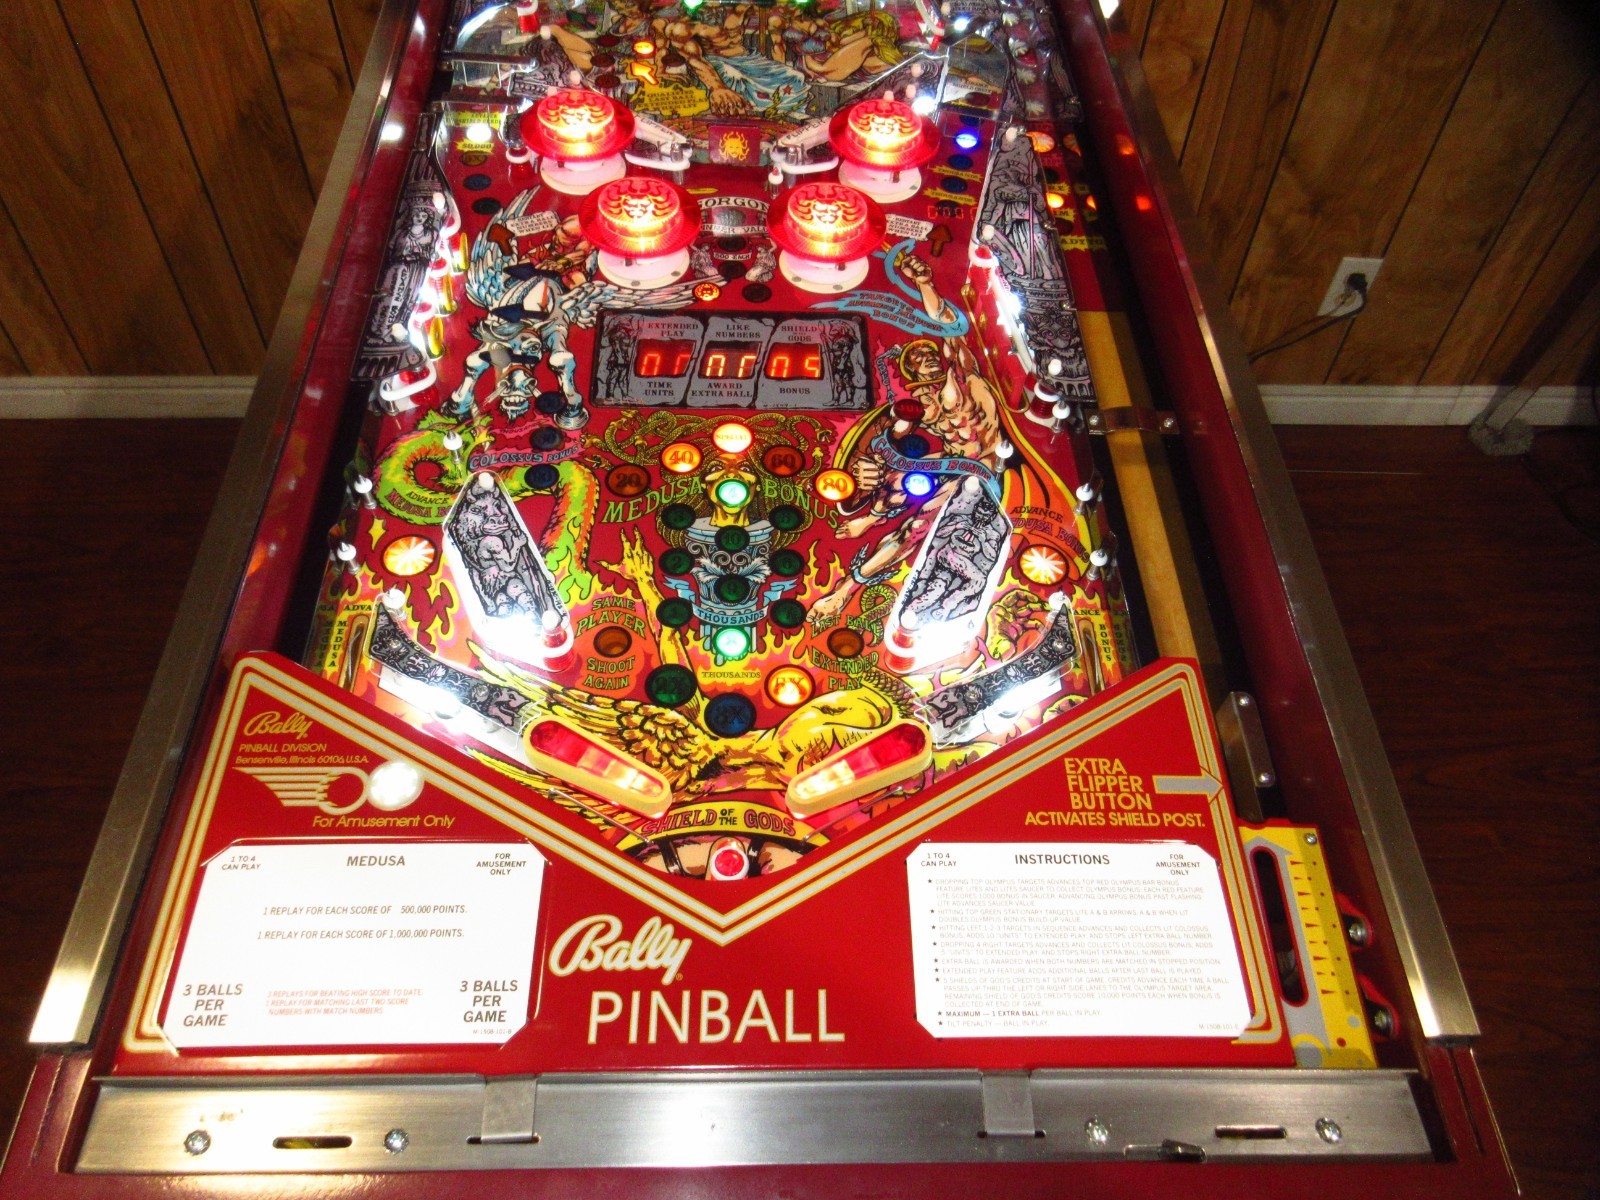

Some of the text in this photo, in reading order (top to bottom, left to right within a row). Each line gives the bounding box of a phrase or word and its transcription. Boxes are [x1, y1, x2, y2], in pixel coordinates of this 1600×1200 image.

[468, 444, 580, 470] COLOSSUS BONUS
[668, 450, 695, 466] 40
[874, 438, 992, 480] COLOSSUS BONUS
[822, 477, 849, 492] 80
[385, 488, 432, 518] MEDUSA
[406, 490, 450, 505] ADVANCE
[601, 478, 839, 530] MEDUSA BONUS
[1010, 506, 1064, 524] ADVANCE
[1055, 526, 1090, 564] BONUS
[591, 596, 637, 610] SAME
[576, 609, 648, 640] PLAYER
[695, 608, 766, 626] THOUSANDS
[809, 616, 883, 638] LAST BALL
[1099, 624, 1112, 662] BONUS
[586, 655, 636, 674] SHOOT
[809, 648, 880, 674] EXTENDED
[582, 675, 631, 690] AGAIN
[700, 670, 762, 680] THOUSANDS
[828, 677, 865, 690] PLAY
[243, 711, 313, 740] Bally
[239, 743, 328, 753] PINBALL DIVISION
[1064, 758, 1128, 776] EXTRA
[1066, 774, 1144, 793] FLIPPER
[1069, 792, 1153, 811] BUTTON
[312, 814, 456, 828] For Amusement Only
[641, 808, 797, 838] SHIELD OF THE GODS
[1024, 811, 1206, 828] ACTIVATES SHIELD POST.
[346, 855, 406, 867] MEDUSA
[1014, 854, 1110, 866] INSTRUCTIONS
[264, 905, 468, 916] 1 REPLAY FOR EACH SCORE OF 500,000 POINTS.
[257, 930, 465, 940] 1 REPLAY FOR EACH SCORE OF 1,000,000 POINTS.
[548, 914, 692, 986] Bally
[182, 984, 244, 996] 3 BALLS
[460, 980, 519, 992] 3 BALLS
[194, 999, 224, 1011] PER
[472, 995, 502, 1007] PER
[183, 1014, 228, 1027] GAME
[463, 1010, 508, 1023] GAME
[587, 989, 846, 1044] PINBALL
